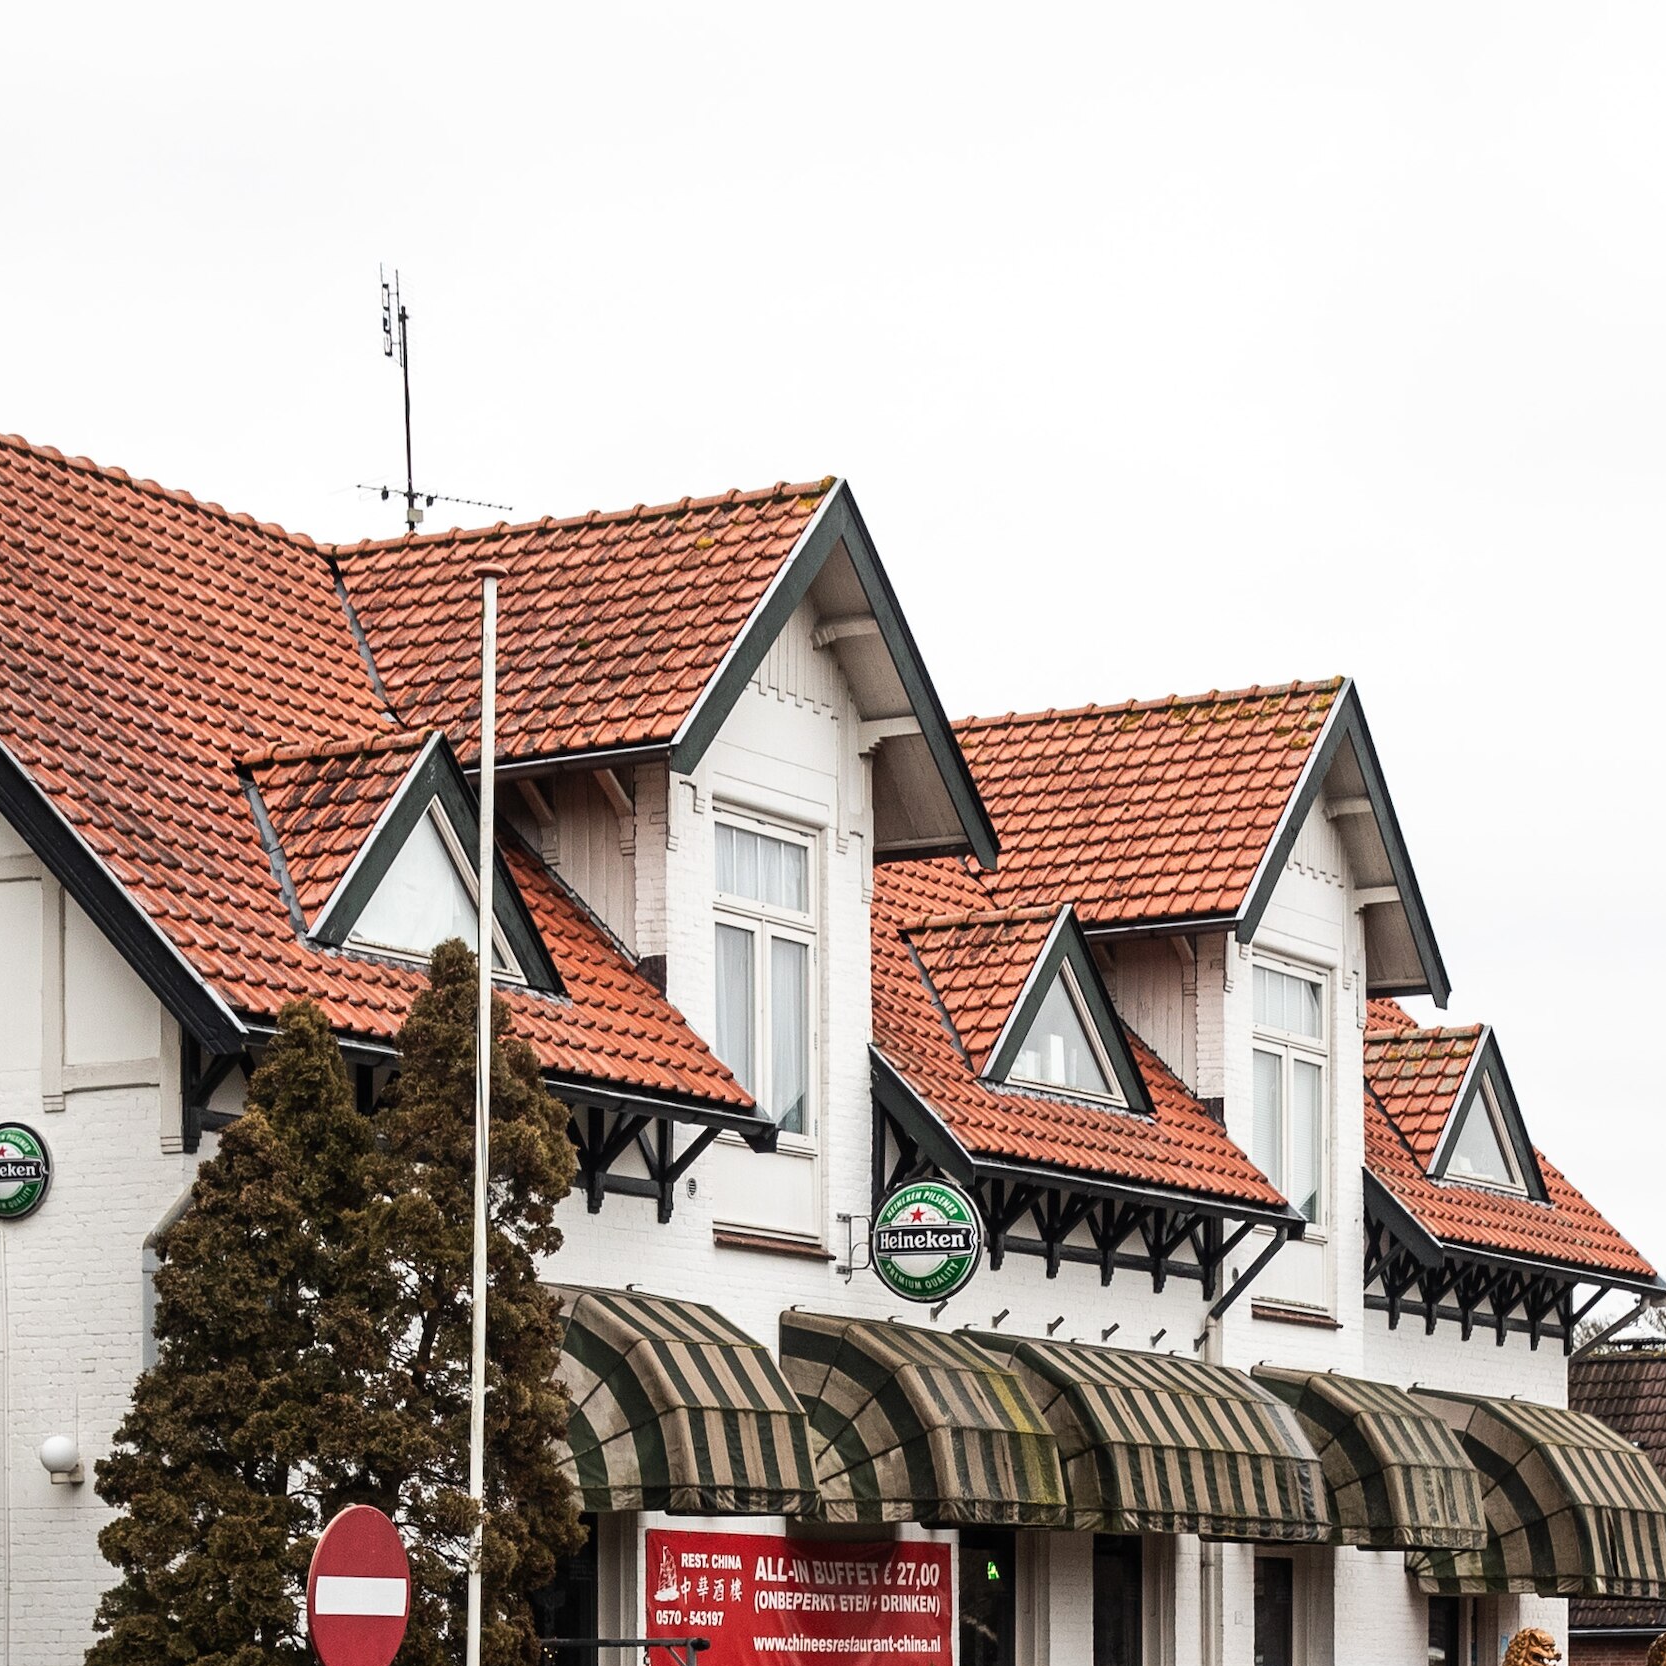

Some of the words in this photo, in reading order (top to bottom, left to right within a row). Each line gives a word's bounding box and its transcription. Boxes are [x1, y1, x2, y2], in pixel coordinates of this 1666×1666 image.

[886, 1191, 921, 1219] HEINEKEN
[923, 1190, 958, 1217] PILSENER
[880, 1230, 965, 1250] Heineken
[886, 1263, 922, 1290] PREMIUM
[924, 1261, 959, 1289] QUALITY
[681, 1552, 709, 1568] REST.
[711, 1554, 743, 1570] CHINA
[754, 1556, 810, 1584] ALL-IN
[812, 1560, 879, 1585] BUFFET
[883, 1562, 893, 1586] €
[896, 1561, 941, 1591] 27,00
[754, 1590, 836, 1613] (ONBEPERKT
[840, 1593, 869, 1612] ETEN
[880, 1594, 941, 1617] DRINKEN)
[655, 1609, 681, 1625] 0570
[689, 1610, 724, 1626] 543197
[753, 1633, 941, 1653] www.chineesrestaurant-china.nl
